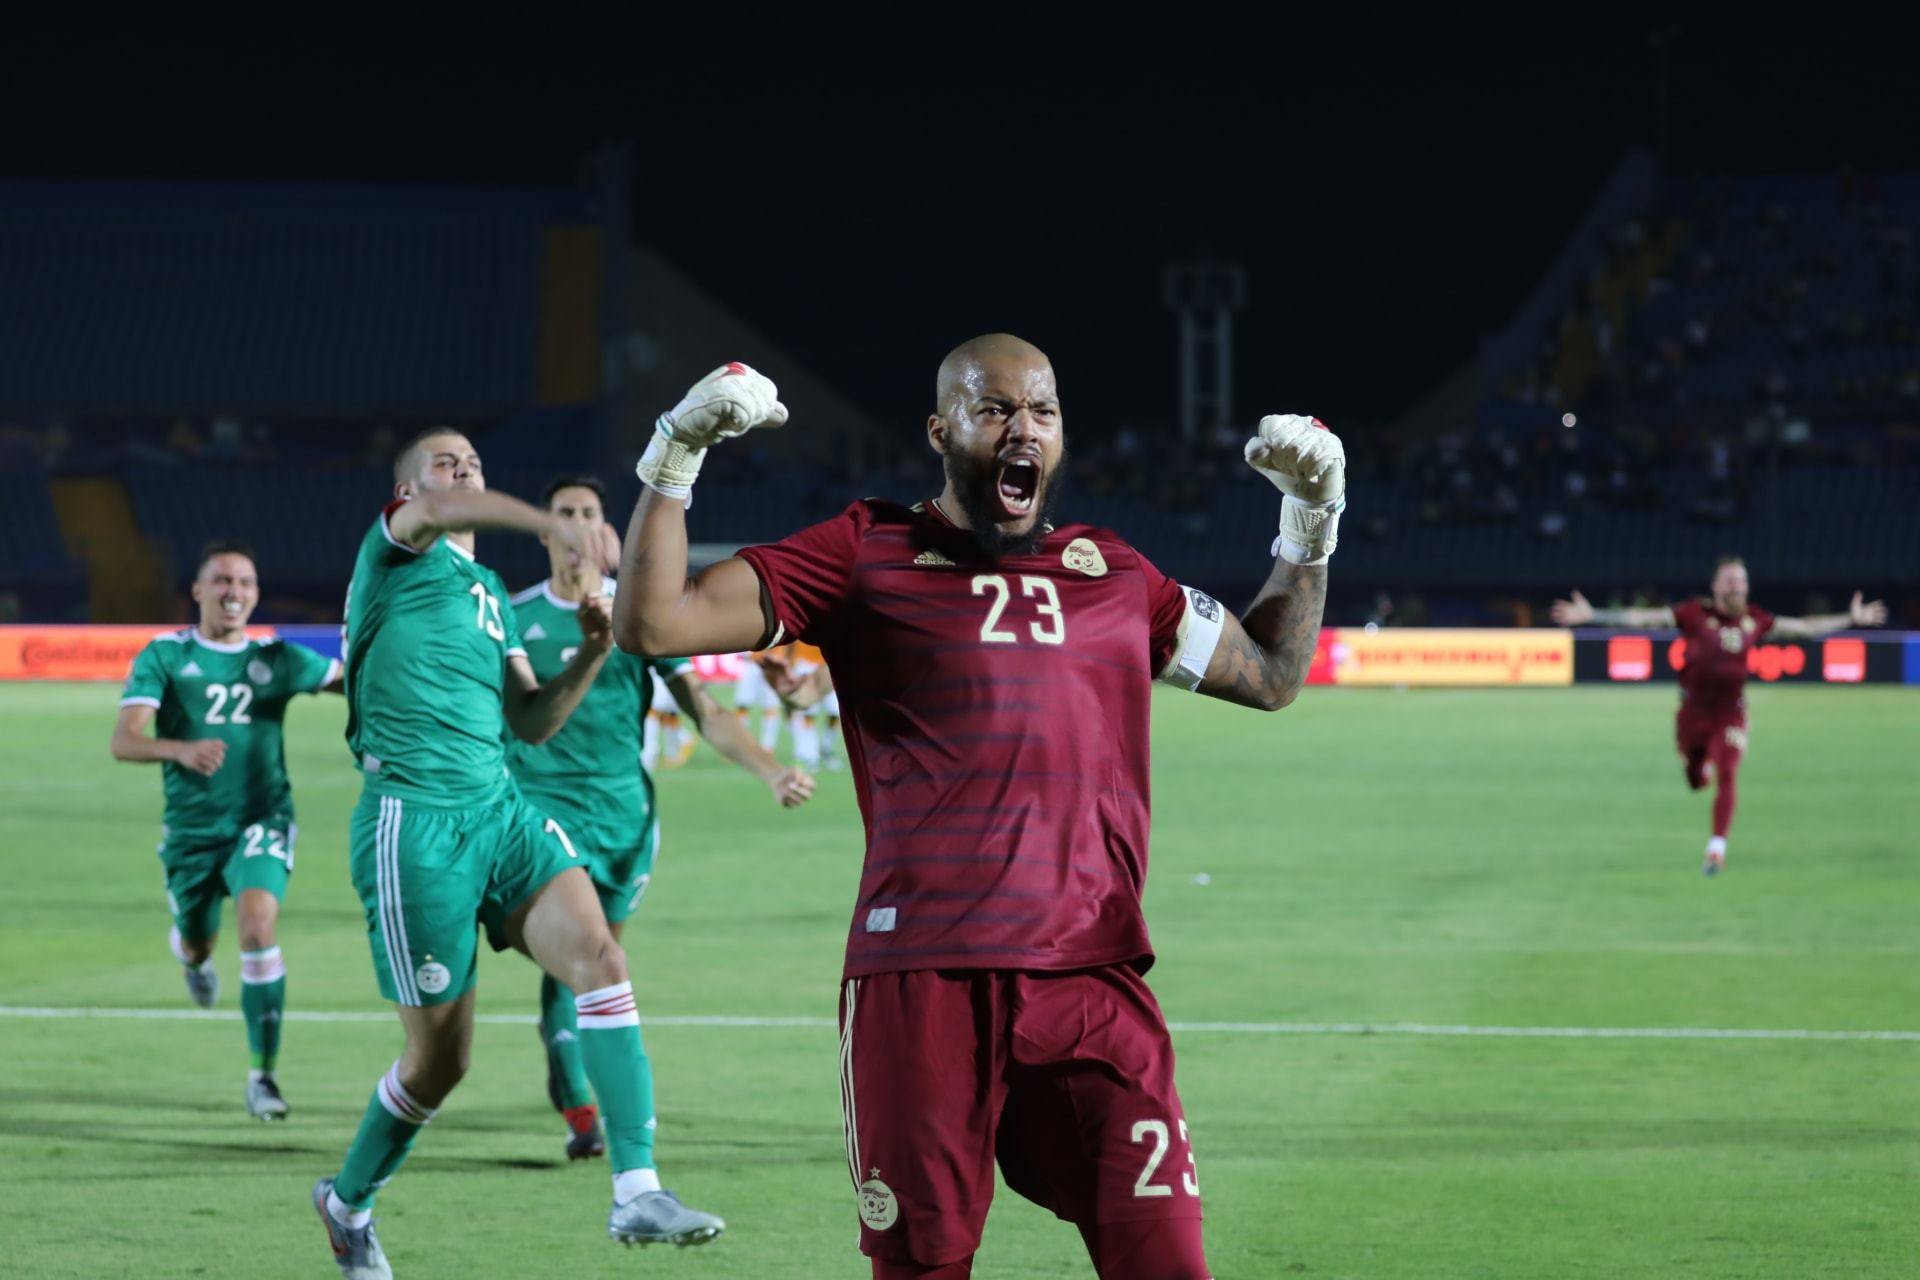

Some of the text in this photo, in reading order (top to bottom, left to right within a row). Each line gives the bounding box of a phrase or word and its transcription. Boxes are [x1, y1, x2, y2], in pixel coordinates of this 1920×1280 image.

[469, 581, 505, 642] 13
[971, 575, 1066, 646] 23
[205, 683, 253, 725] 22
[243, 823, 287, 861] 22
